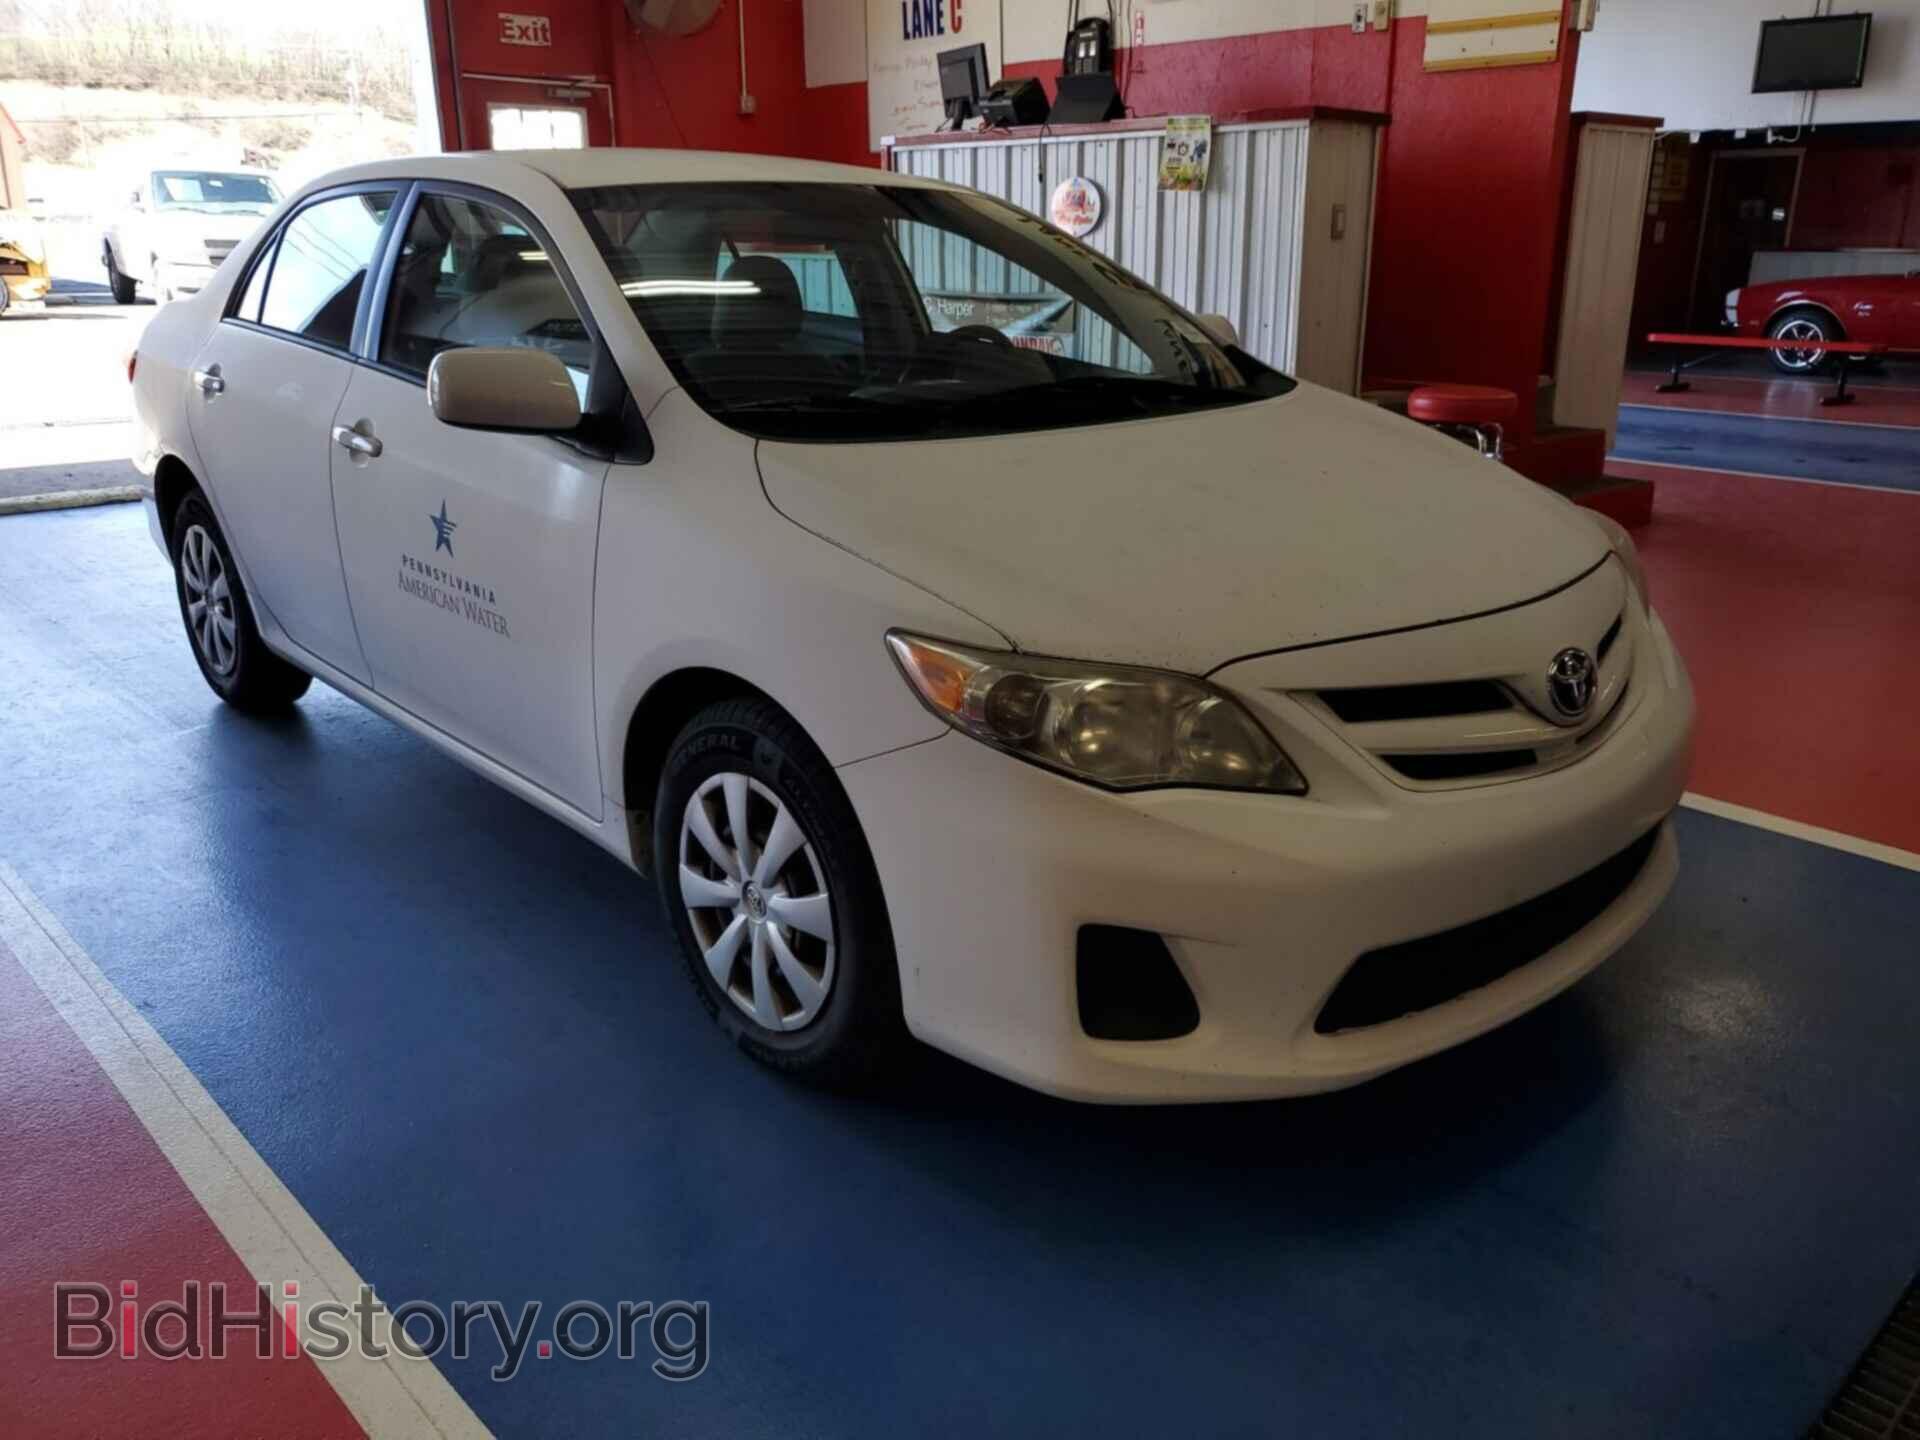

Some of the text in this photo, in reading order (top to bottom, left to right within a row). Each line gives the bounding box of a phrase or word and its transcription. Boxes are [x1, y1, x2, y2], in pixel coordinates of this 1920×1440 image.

[498, 16, 549, 42] Exit
[902, 0, 962, 40] LANE C
[937, 297, 976, 321] Harper
[402, 553, 496, 605] PENNSYLVANIA
[397, 569, 511, 639] AMERICAN WATER
